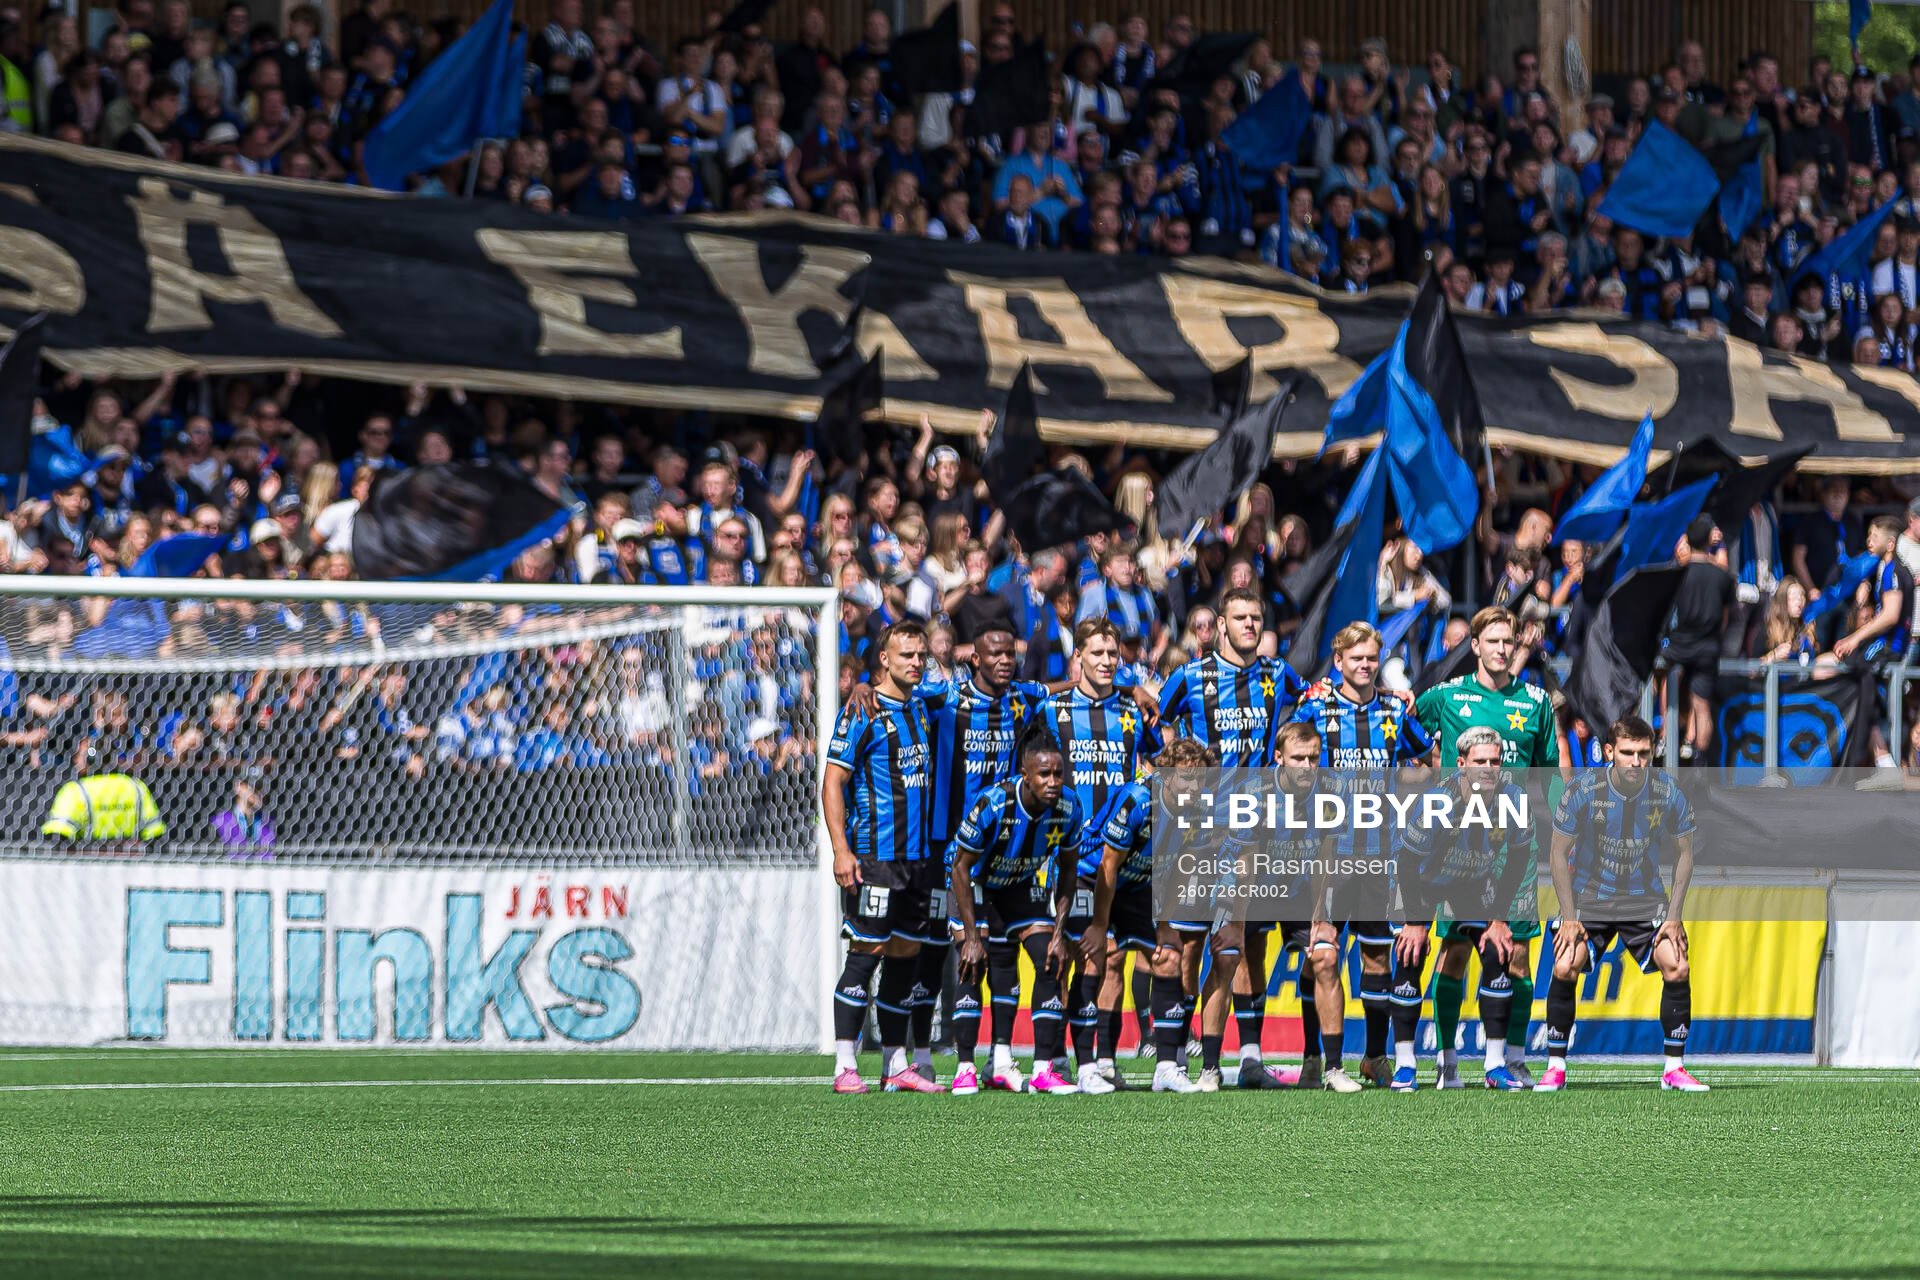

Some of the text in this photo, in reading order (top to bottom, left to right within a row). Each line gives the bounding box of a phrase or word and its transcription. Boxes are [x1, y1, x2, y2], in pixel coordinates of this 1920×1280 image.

[1214, 708, 1242, 720] BYGG
[1214, 719, 1269, 732] CONSTRUCT
[964, 729, 992, 741] BYGG
[963, 741, 1015, 753] CONSTRUCT
[1069, 740, 1098, 752] BYGG
[1069, 751, 1128, 764] CONSTRUCT
[1333, 748, 1362, 760] BYGG
[1333, 759, 1390, 772] CONSTRUCT
[505, 874, 629, 919] JÄRN
[124, 888, 642, 1044] Flinks
